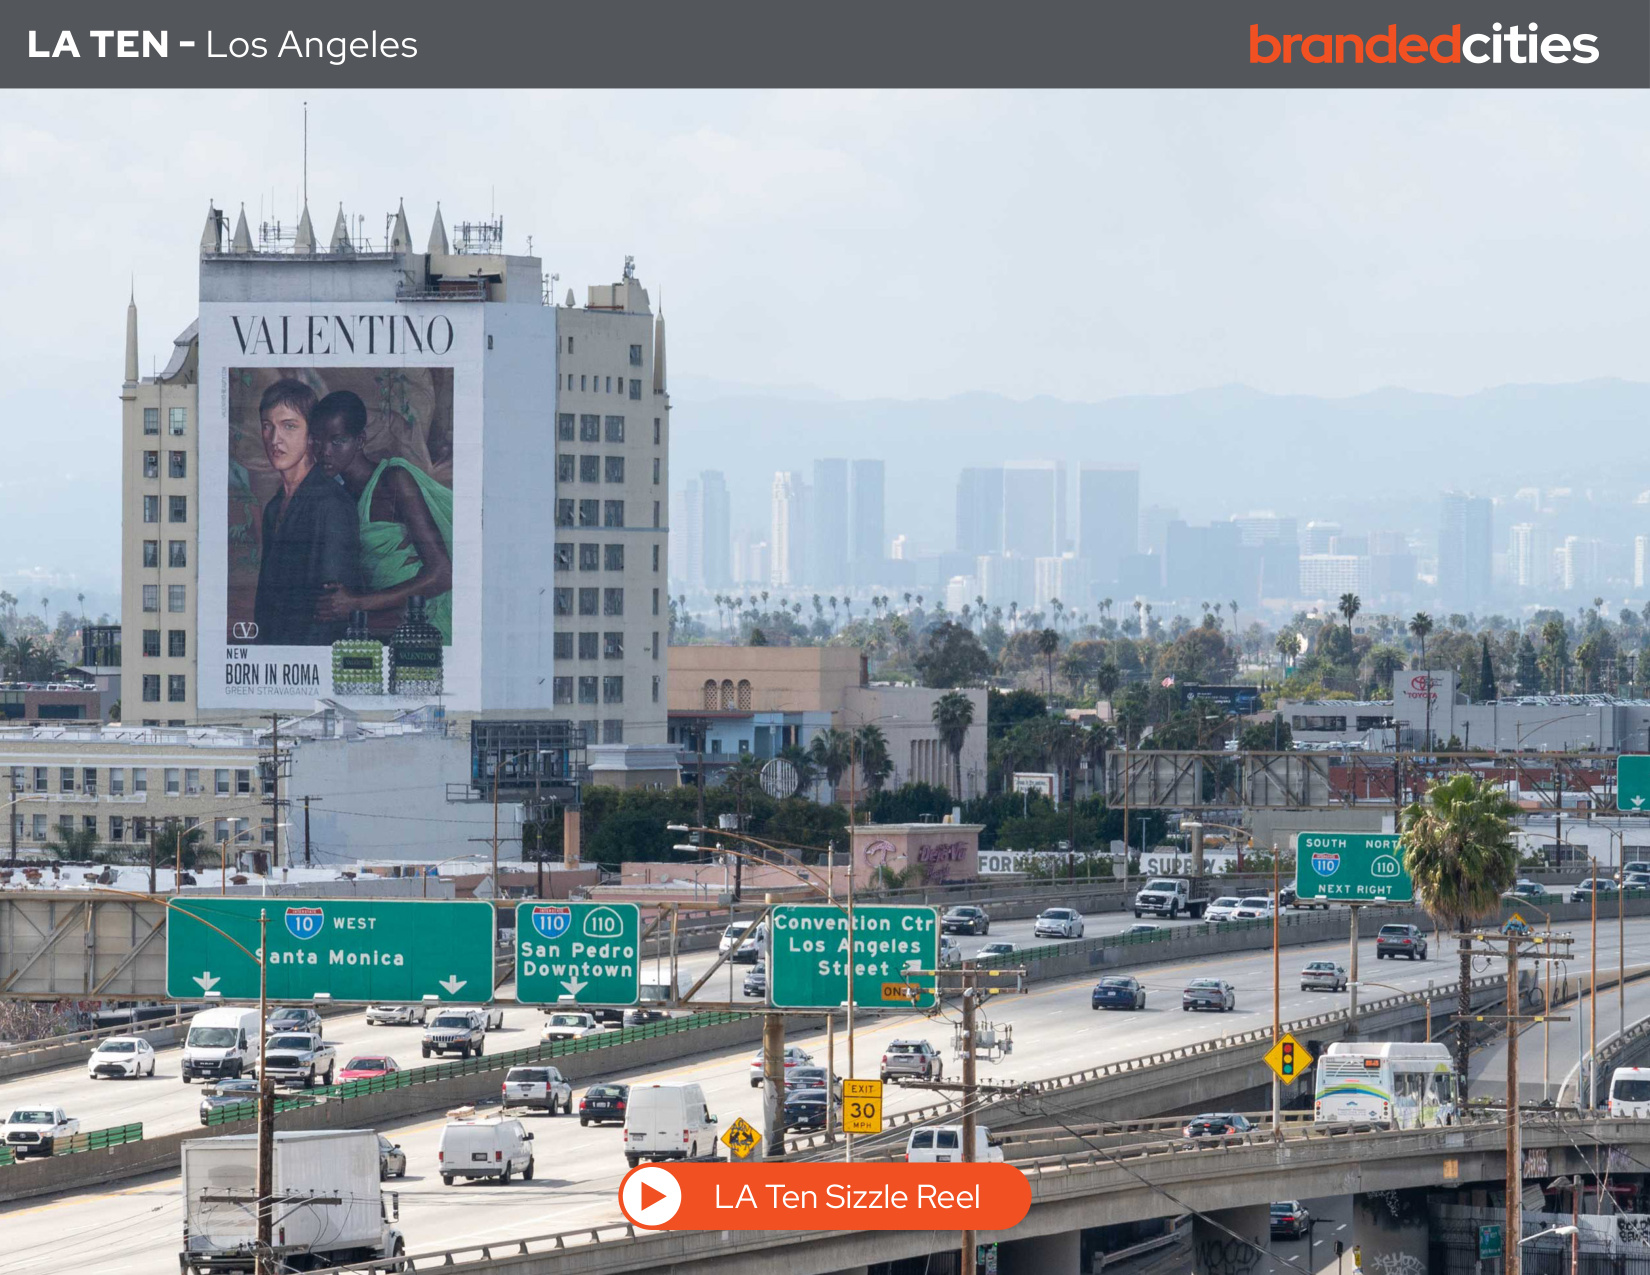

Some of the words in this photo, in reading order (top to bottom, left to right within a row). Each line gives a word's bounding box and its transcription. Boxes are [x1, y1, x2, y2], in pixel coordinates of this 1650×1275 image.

[230, 315, 454, 356] VALENTINO
[226, 648, 248, 660] NEW
[225, 663, 260, 685] BORN
[265, 664, 277, 685] IN
[283, 664, 320, 686] ROMA
[225, 686, 254, 695] GREEN
[257, 687, 320, 697] STRAVAGANZA
[1306, 838, 1347, 848] SOUTH
[1147, 858, 1216, 875] SUPPY
[1317, 860, 1335, 871] 110
[1377, 862, 1395, 873] 110
[1318, 884, 1351, 893] NEXT
[1357, 885, 1393, 894] RIGHT
[295, 917, 313, 932] 10
[333, 917, 376, 930] WEST
[540, 916, 564, 931] 110
[591, 917, 615, 932] 110
[774, 914, 891, 931] Convention
[901, 915, 934, 931] Ctr
[521, 942, 560, 958] San
[571, 942, 634, 959] Pedro
[789, 937, 826, 953] Los
[837, 938, 921, 958] Angeles
[329, 949, 404, 966] Monica
[524, 960, 633, 977] Downtown
[851, 1084, 874, 1094] EXIT
[850, 1103, 876, 1119] 30
